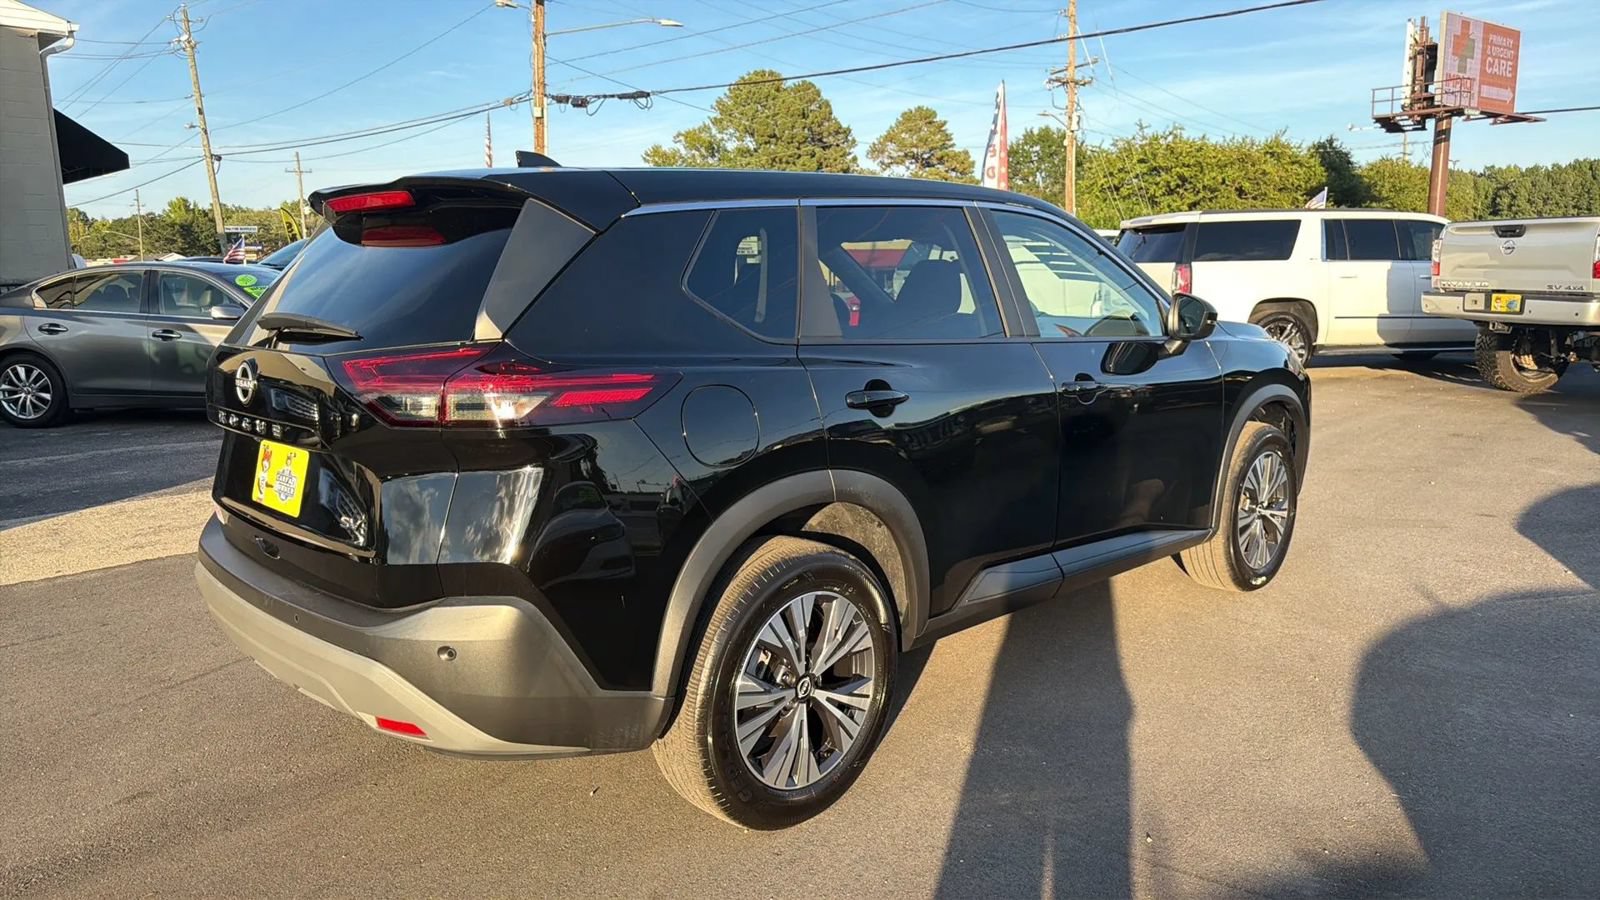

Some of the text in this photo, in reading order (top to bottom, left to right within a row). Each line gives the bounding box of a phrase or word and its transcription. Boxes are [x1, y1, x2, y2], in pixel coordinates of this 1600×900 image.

[1489, 34, 1513, 48] PRIMARY
[1492, 46, 1514, 59] URGENT
[1486, 57, 1512, 77] CARE
[218, 410, 283, 438] ROGUE
